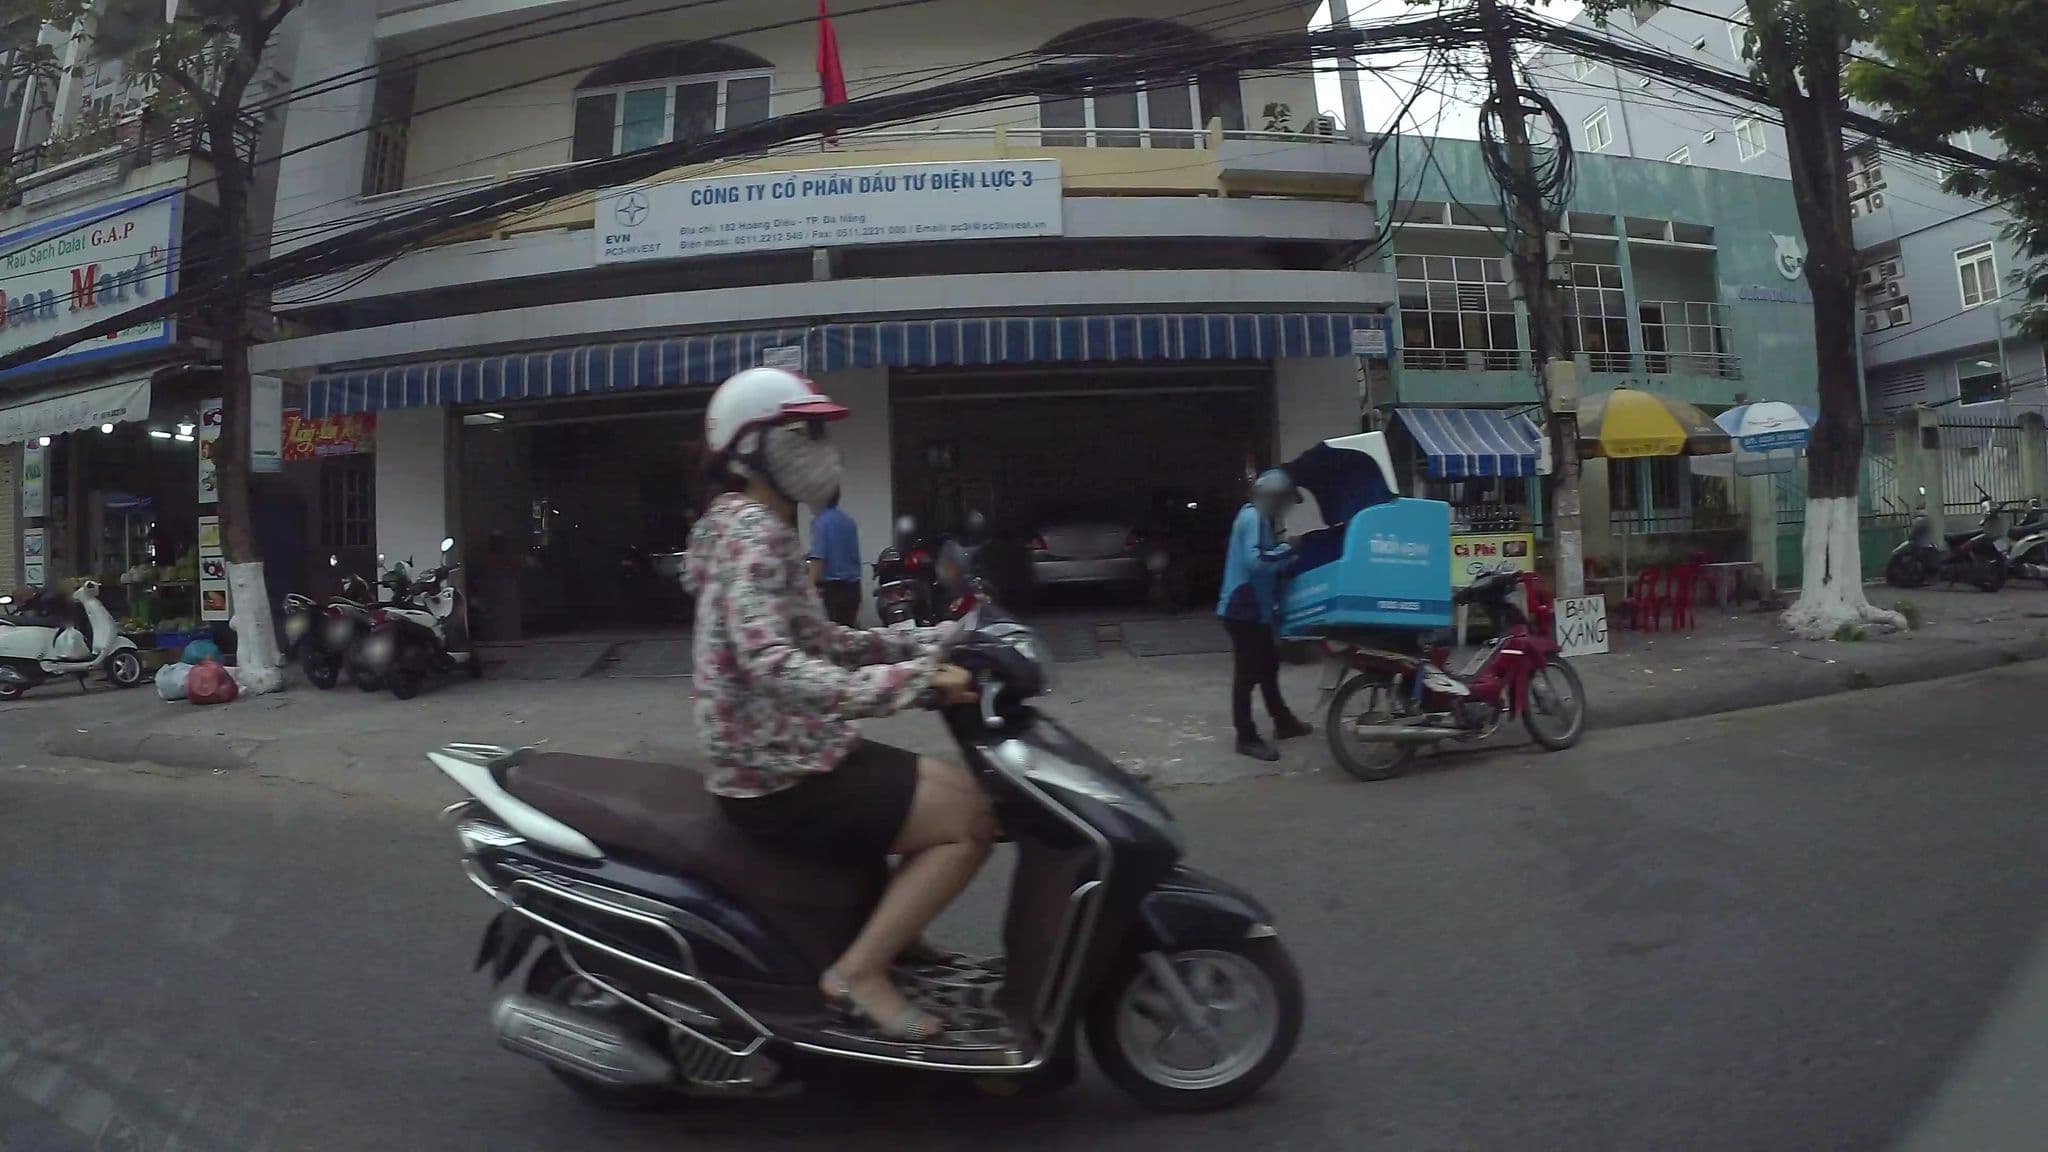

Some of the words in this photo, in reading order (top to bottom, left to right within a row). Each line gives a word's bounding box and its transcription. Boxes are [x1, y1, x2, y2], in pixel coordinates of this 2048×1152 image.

[691, 185, 739, 206] CÔNG
[746, 183, 765, 201] TY
[903, 172, 927, 191] TƯ
[931, 169, 975, 193] ĐIỆN
[981, 169, 1015, 192] LỰC
[1022, 170, 1033, 187] 3
[7, 254, 26, 269] Rau
[91, 222, 135, 247] G.A.P
[606, 234, 630, 244] EVN
